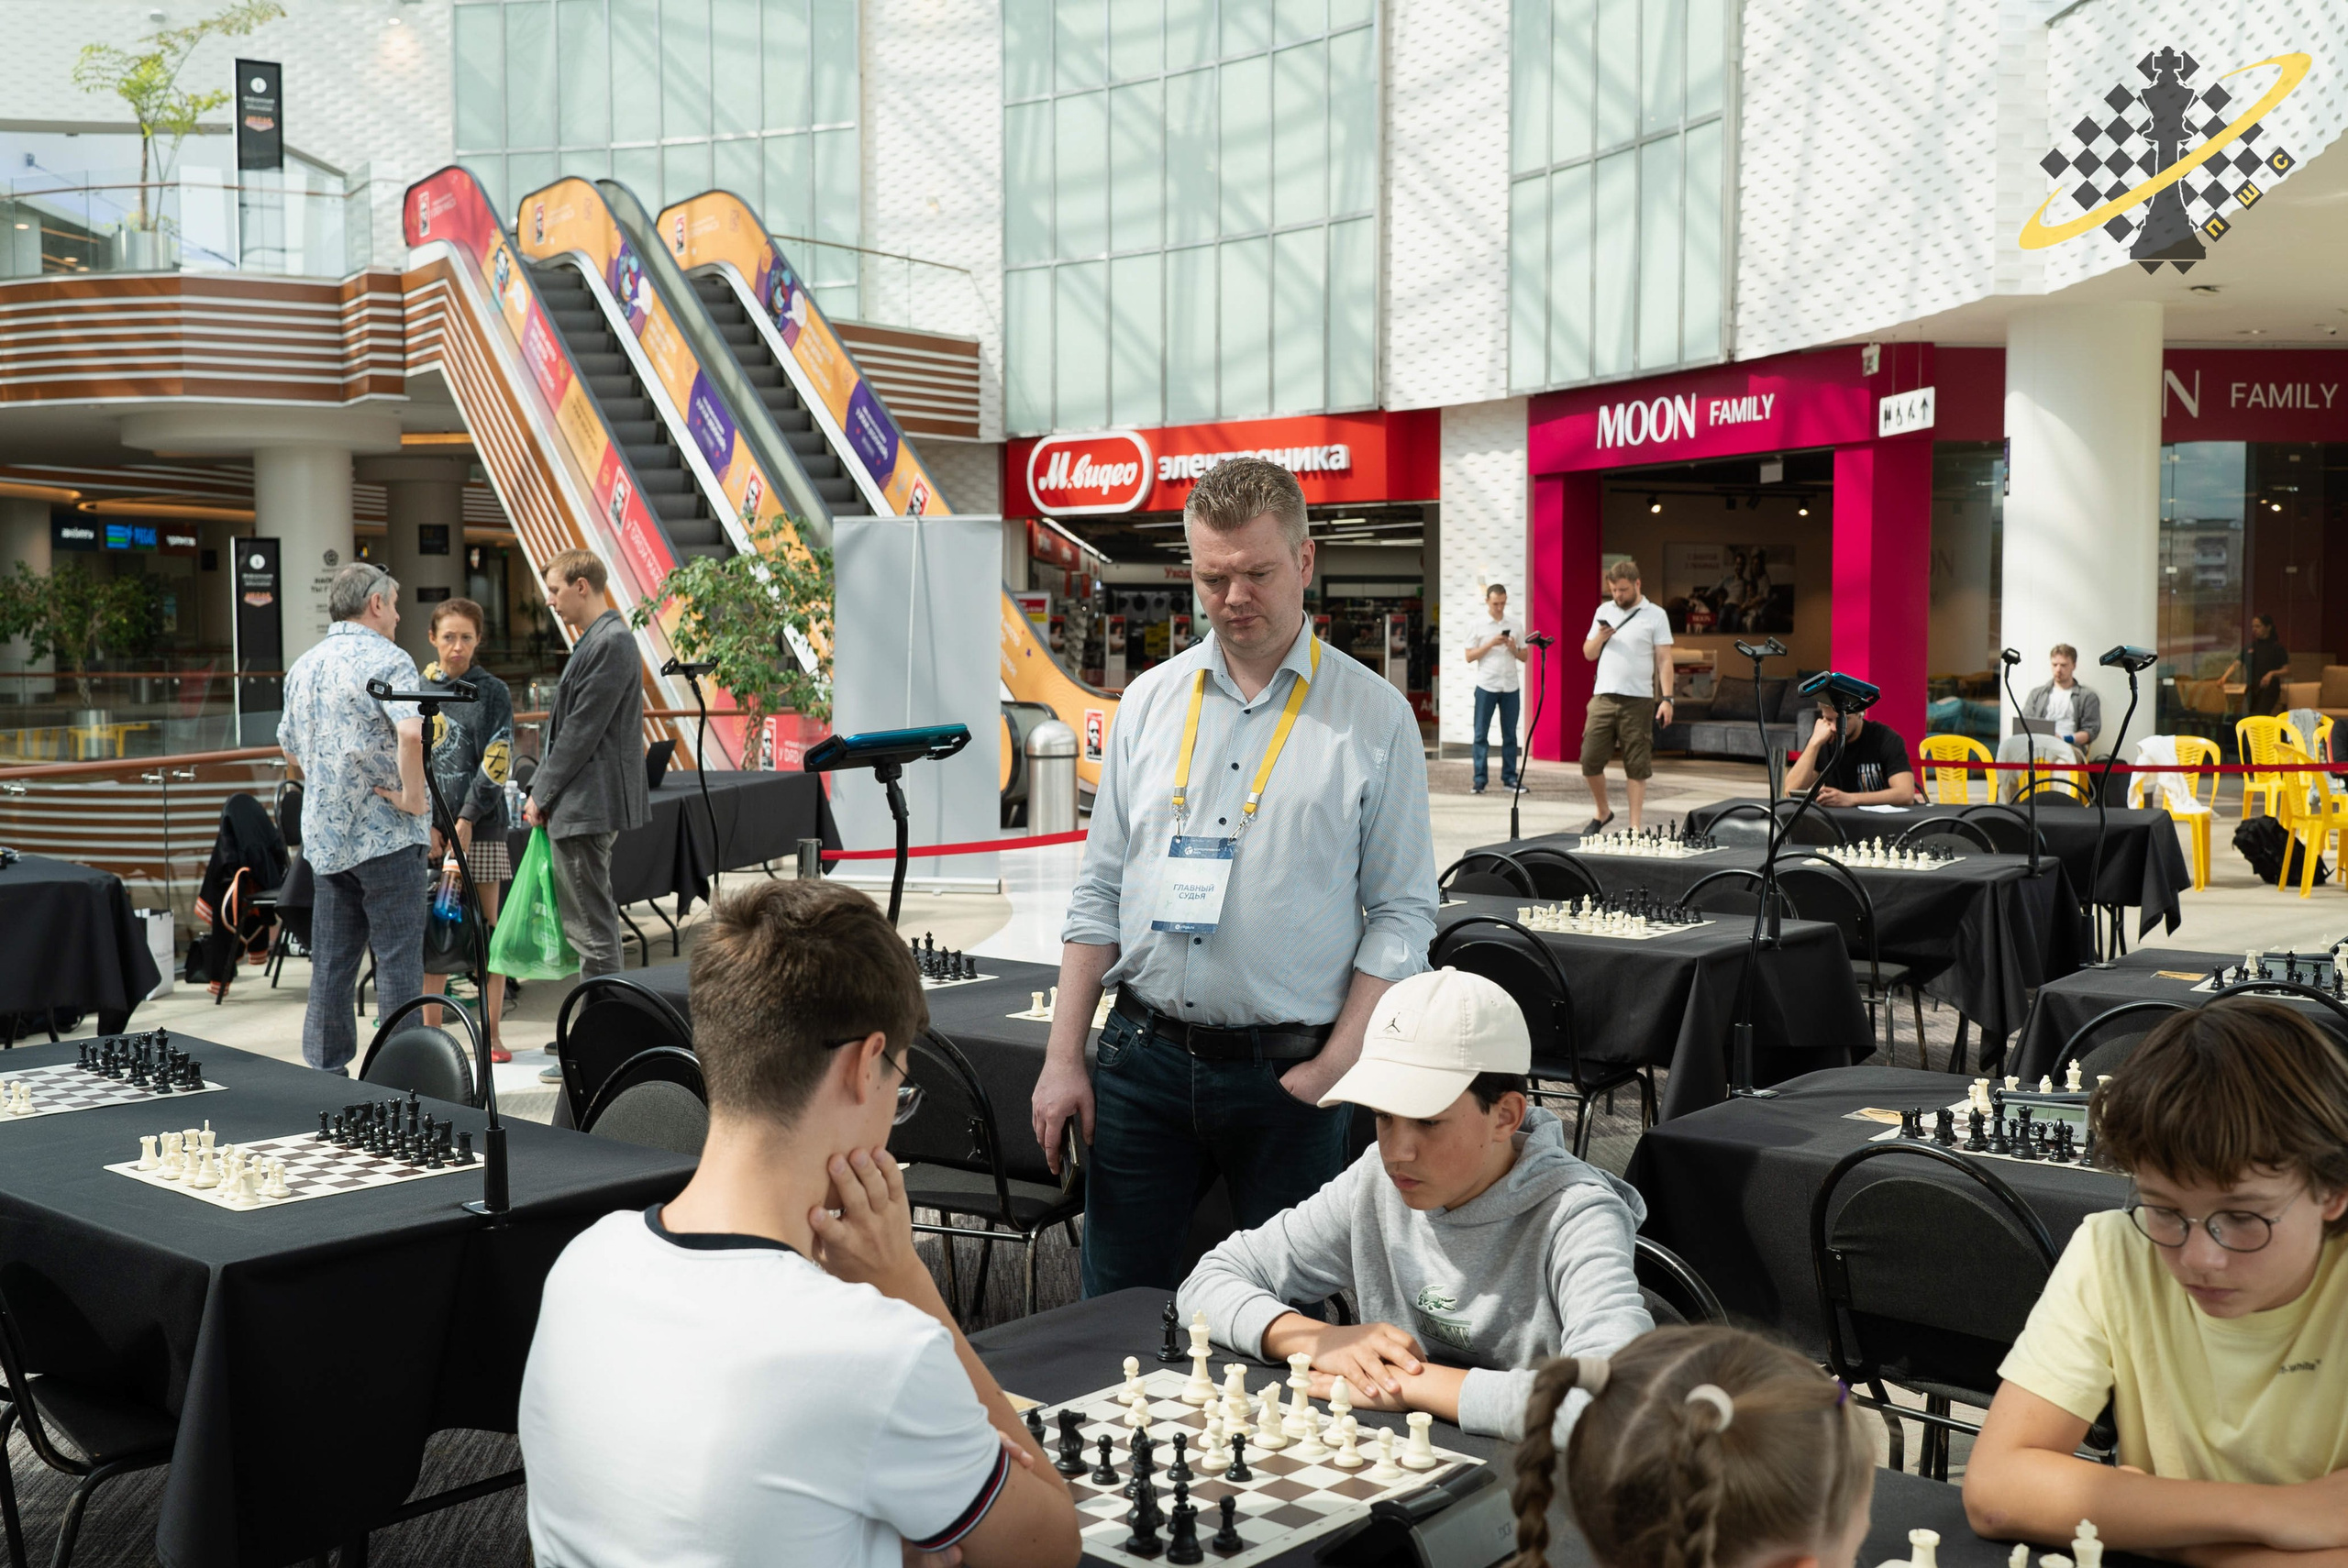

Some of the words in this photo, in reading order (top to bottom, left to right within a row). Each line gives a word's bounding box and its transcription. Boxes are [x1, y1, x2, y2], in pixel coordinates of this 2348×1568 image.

[2231, 382, 2338, 409] FAMILY
[1597, 392, 1696, 449] MOON
[1710, 393, 1775, 426] FAMILY
[1173, 883, 1215, 892] ГЛАВНЫЙ
[1179, 892, 1206, 900] СУДЬЯ
